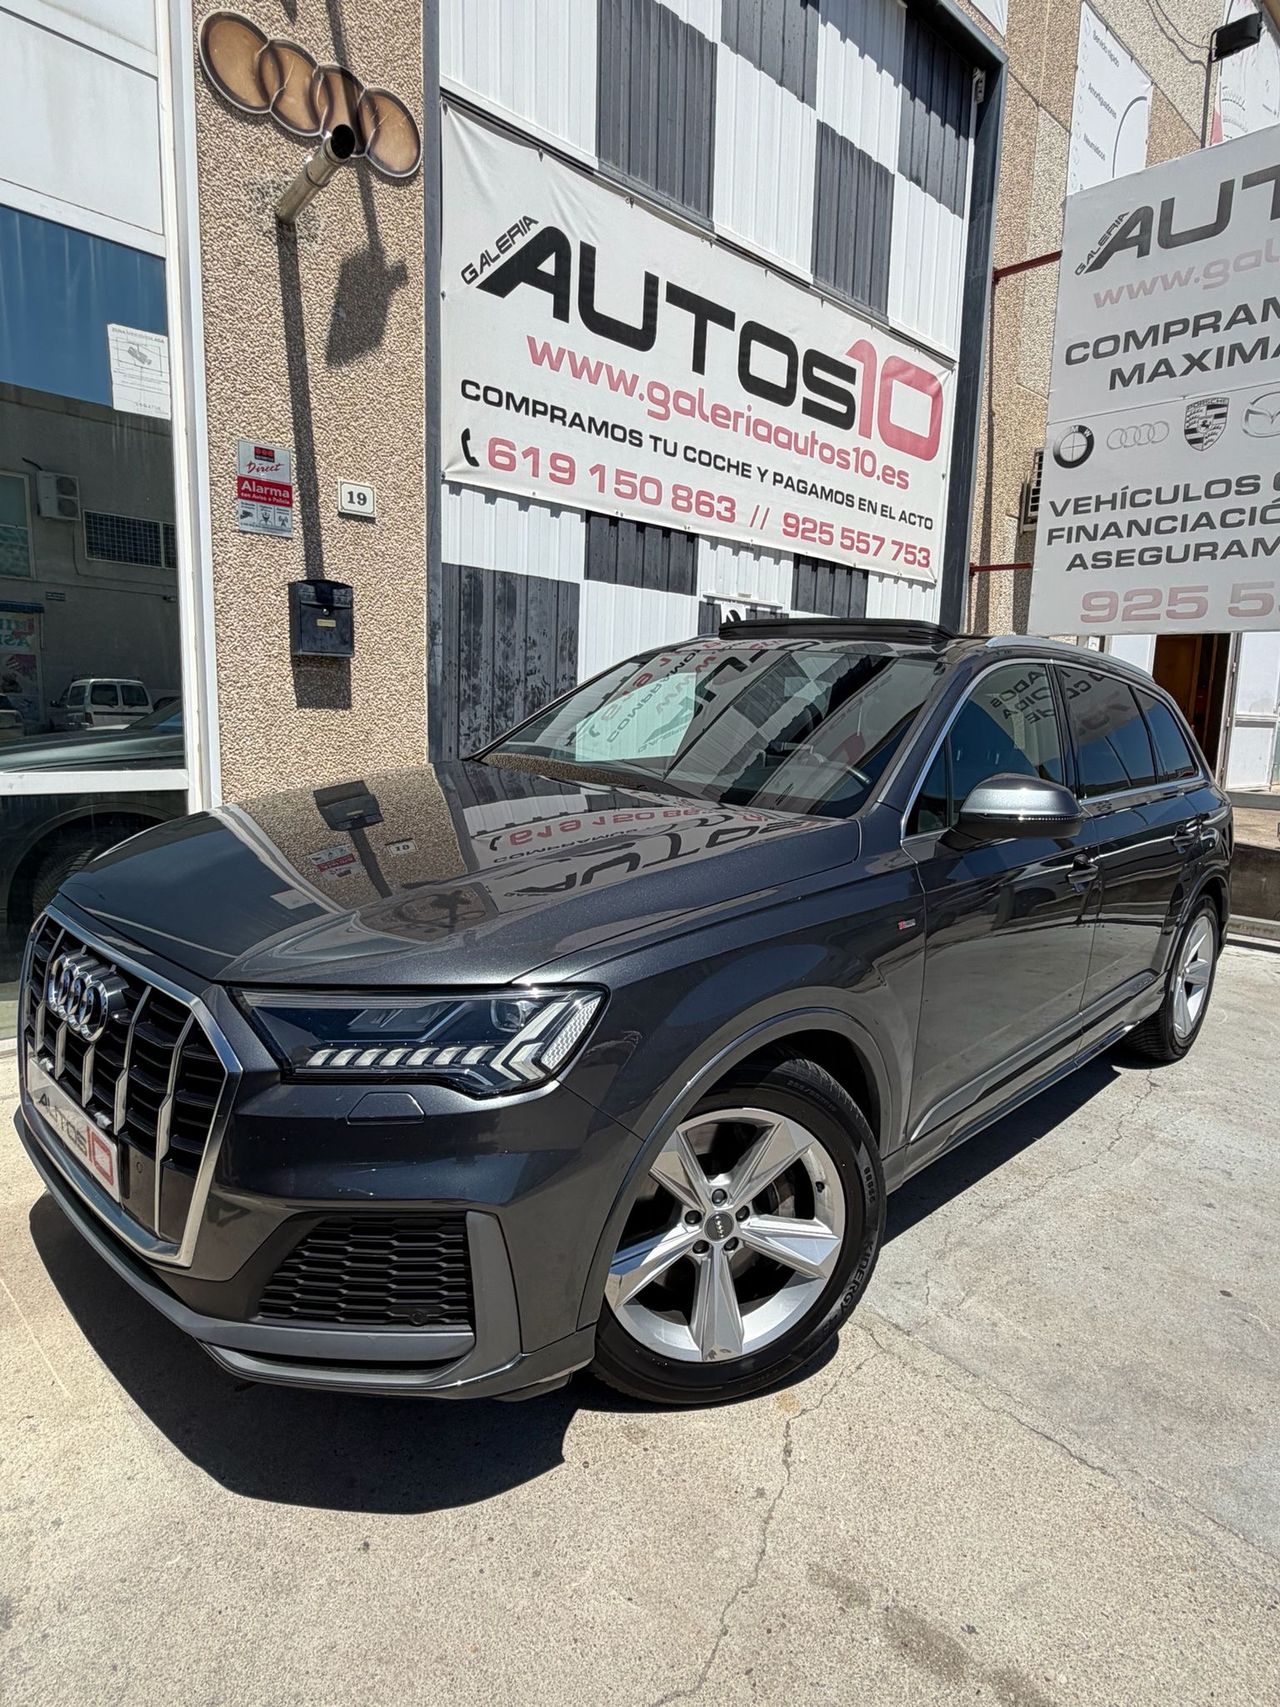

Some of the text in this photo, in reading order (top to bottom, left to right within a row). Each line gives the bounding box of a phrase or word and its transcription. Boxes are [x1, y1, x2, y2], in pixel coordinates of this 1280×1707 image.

[461, 215, 539, 285] GALERIA
[1075, 211, 1129, 276] GALERIA
[526, 334, 911, 490] www.galeriaautos10.es
[246, 460, 285, 474] Direct
[460, 379, 935, 531] COMPRAMOS TU COCHE Y PAGAMOS EN EL ACTO
[241, 480, 290, 499] Alarma
[347, 490, 367, 506] 19
[487, 436, 577, 486] 619
[588, 463, 663, 506] 150
[671, 483, 737, 523] 863
[782, 511, 835, 547] 925
[840, 526, 886, 557] 557
[890, 540, 931, 569] 753
[1049, 474, 1261, 518] VEHÍCULOS
[1080, 584, 1209, 624] 925
[39, 1093, 114, 1187] AUTOS10
